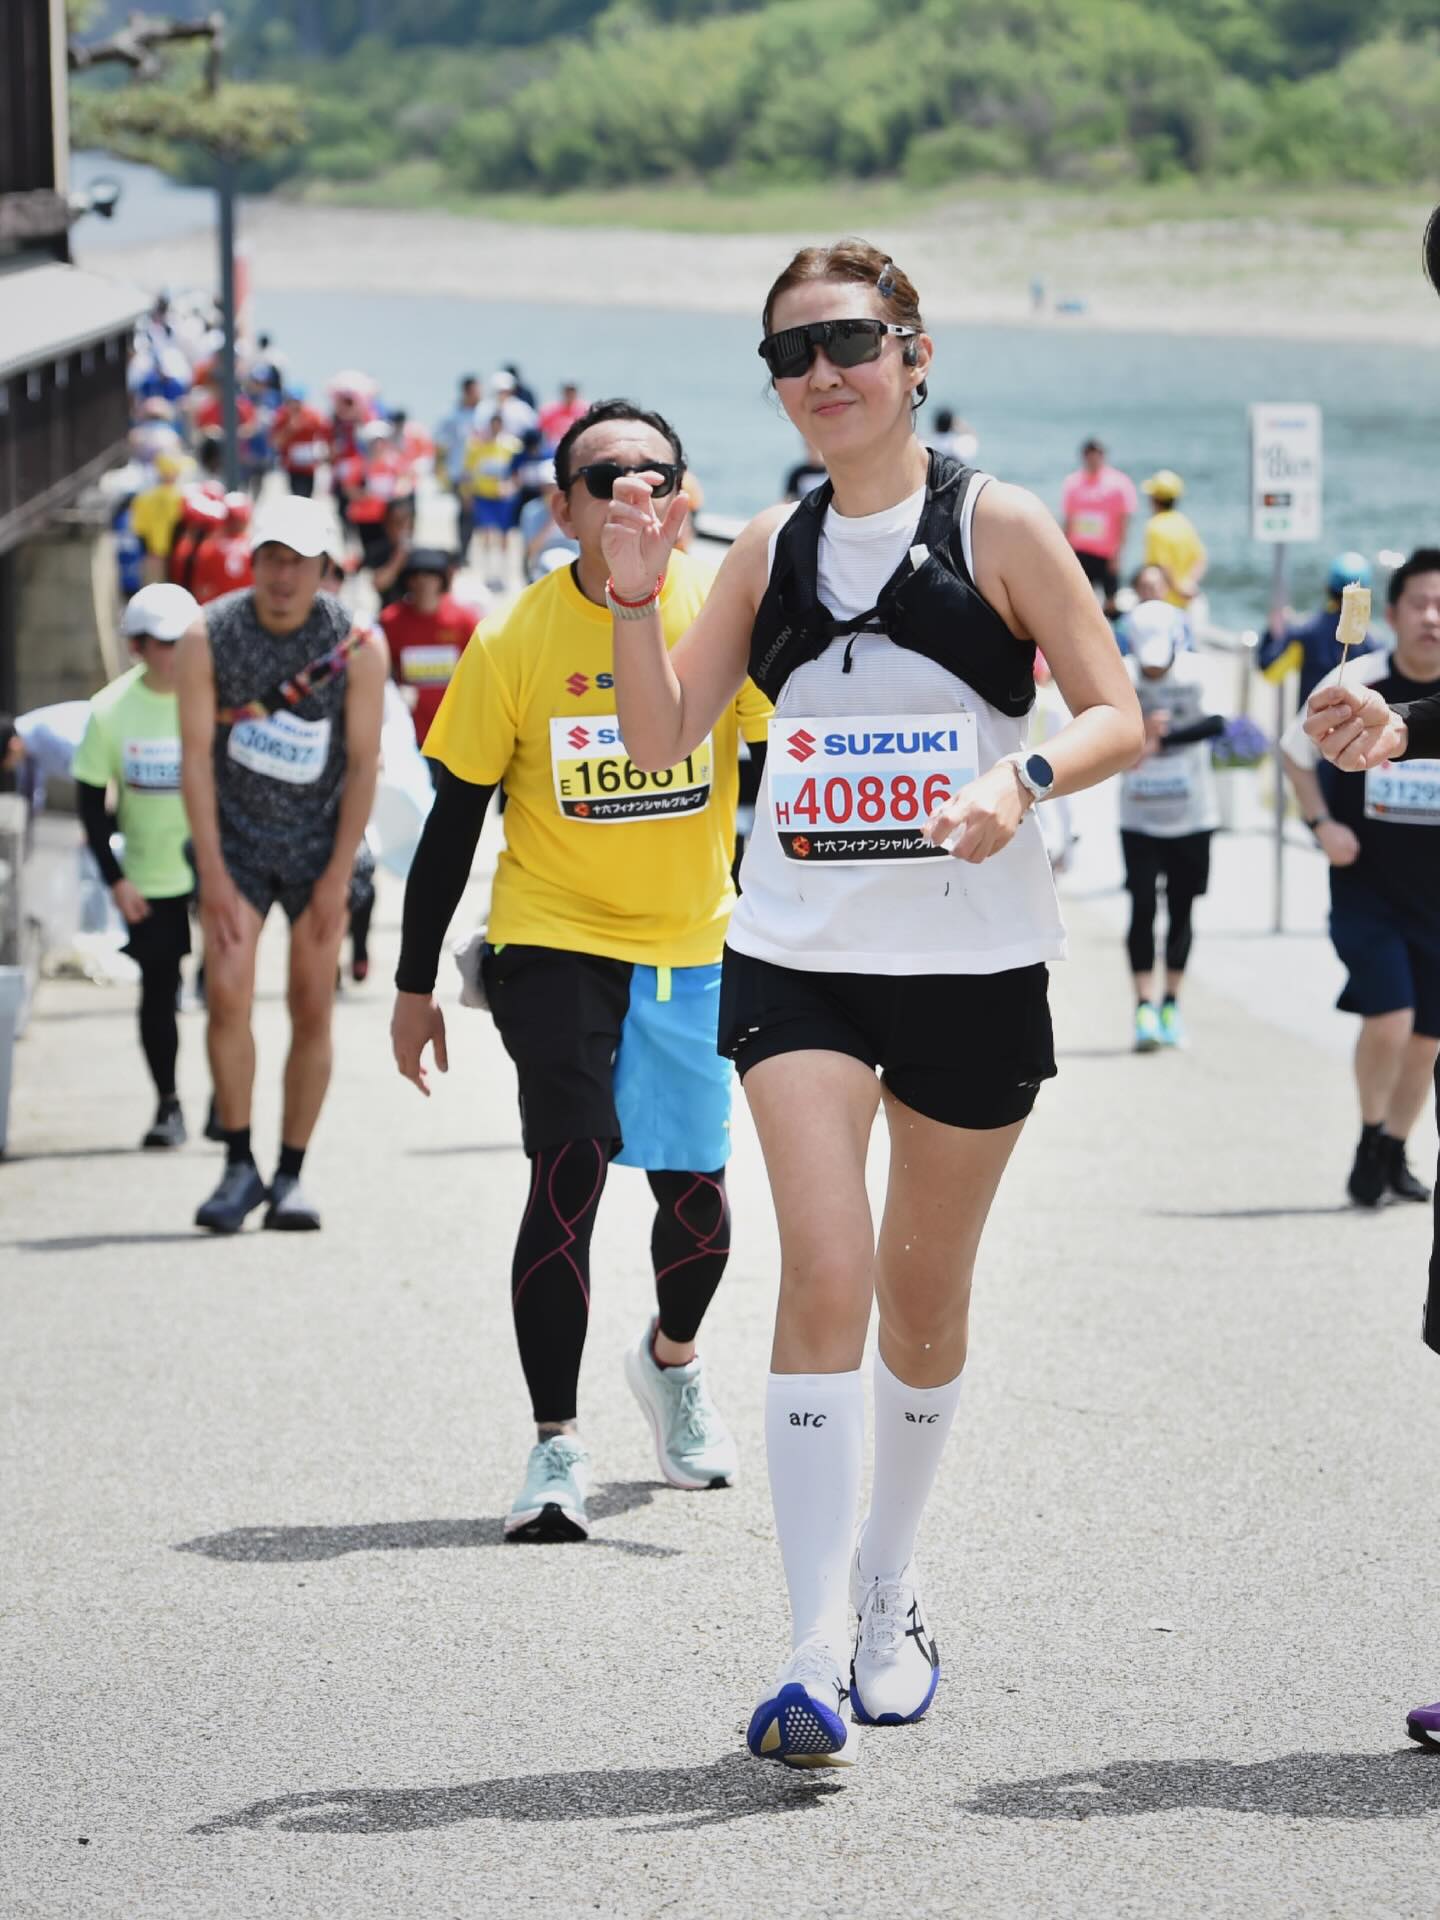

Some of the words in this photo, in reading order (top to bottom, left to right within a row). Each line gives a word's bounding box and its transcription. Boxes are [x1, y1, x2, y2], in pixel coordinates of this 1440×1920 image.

[757, 625, 793, 680] SALOMON
[824, 730, 958, 756] SUZUKI
[789, 1412, 827, 1428] arc
[904, 1411, 940, 1424] arc
